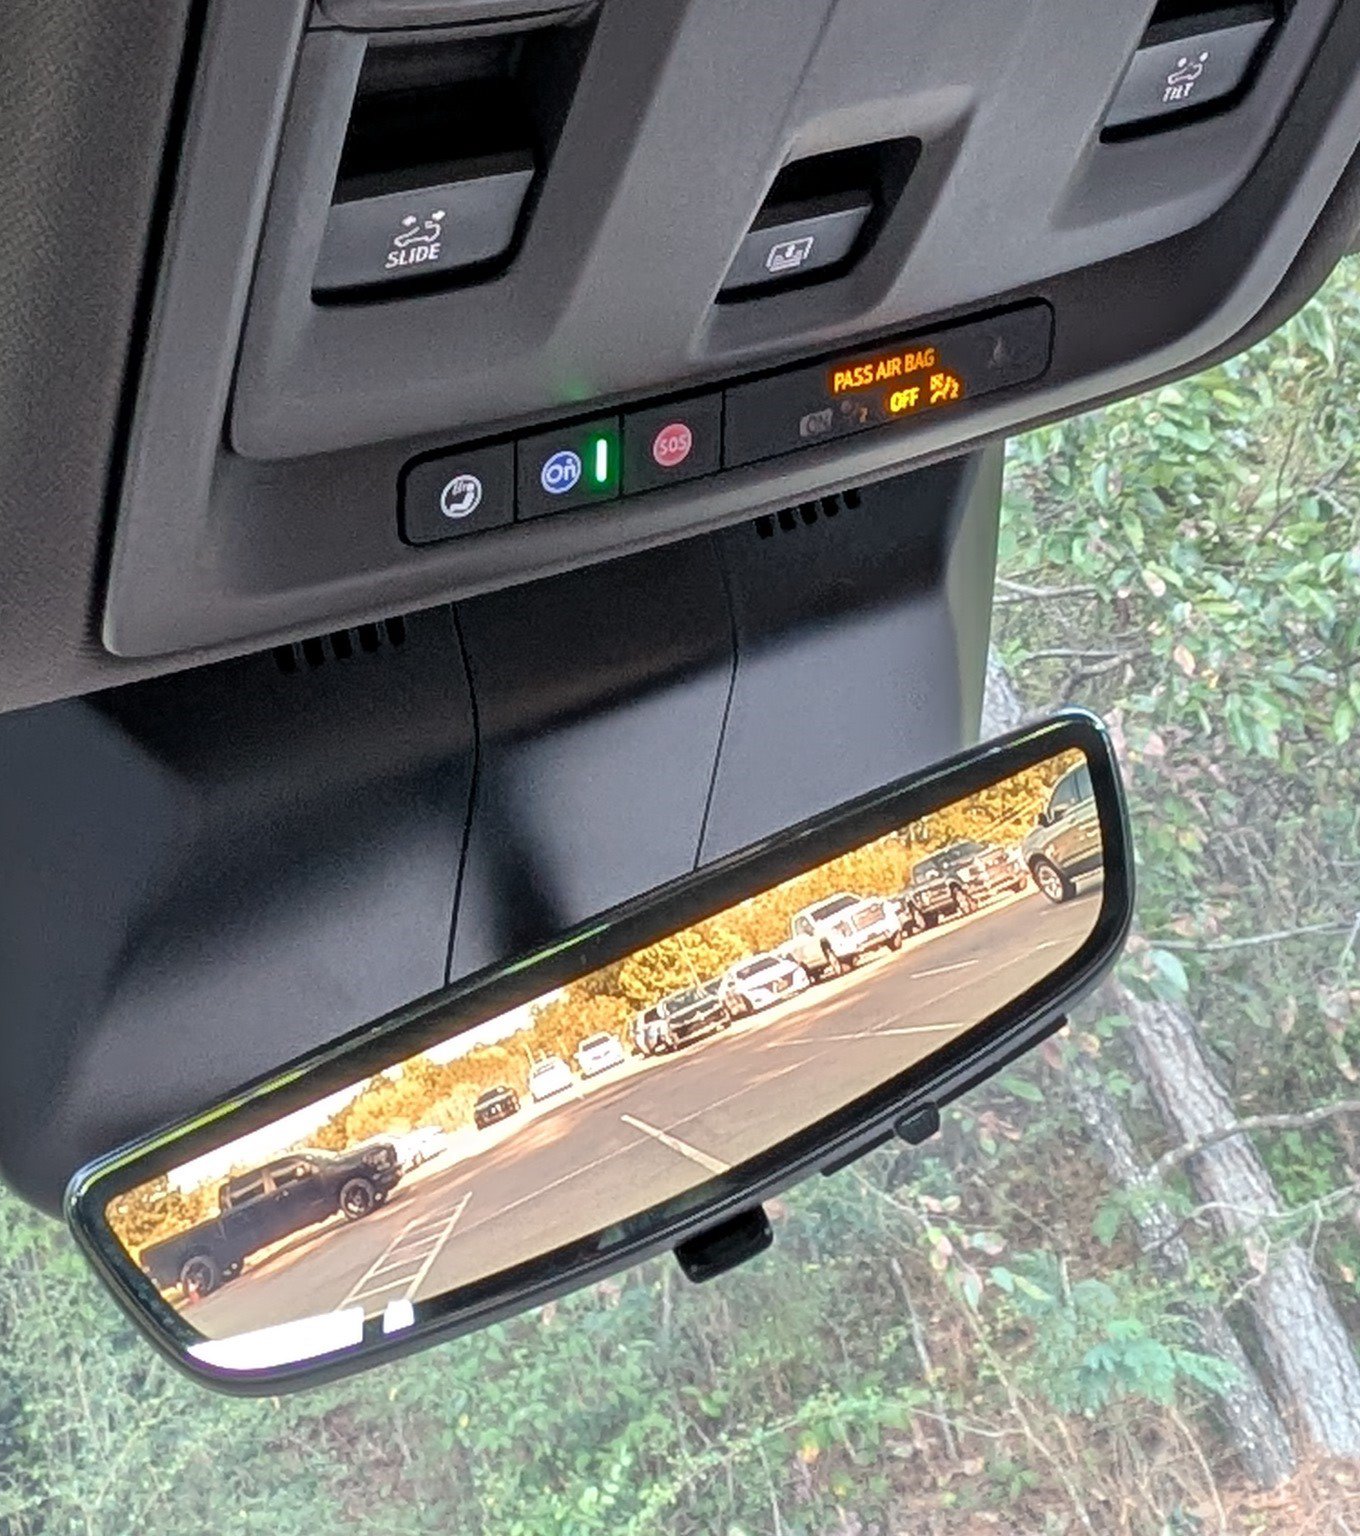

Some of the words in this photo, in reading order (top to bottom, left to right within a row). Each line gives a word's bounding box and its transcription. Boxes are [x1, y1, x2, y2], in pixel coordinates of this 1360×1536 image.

[1162, 81, 1195, 103] TILT
[384, 242, 441, 269] SLIDE
[833, 363, 874, 394] PASS
[875, 356, 903, 382] AIR
[904, 347, 936, 374] BAG
[889, 386, 920, 413] OFF
[658, 433, 688, 455] SOS
